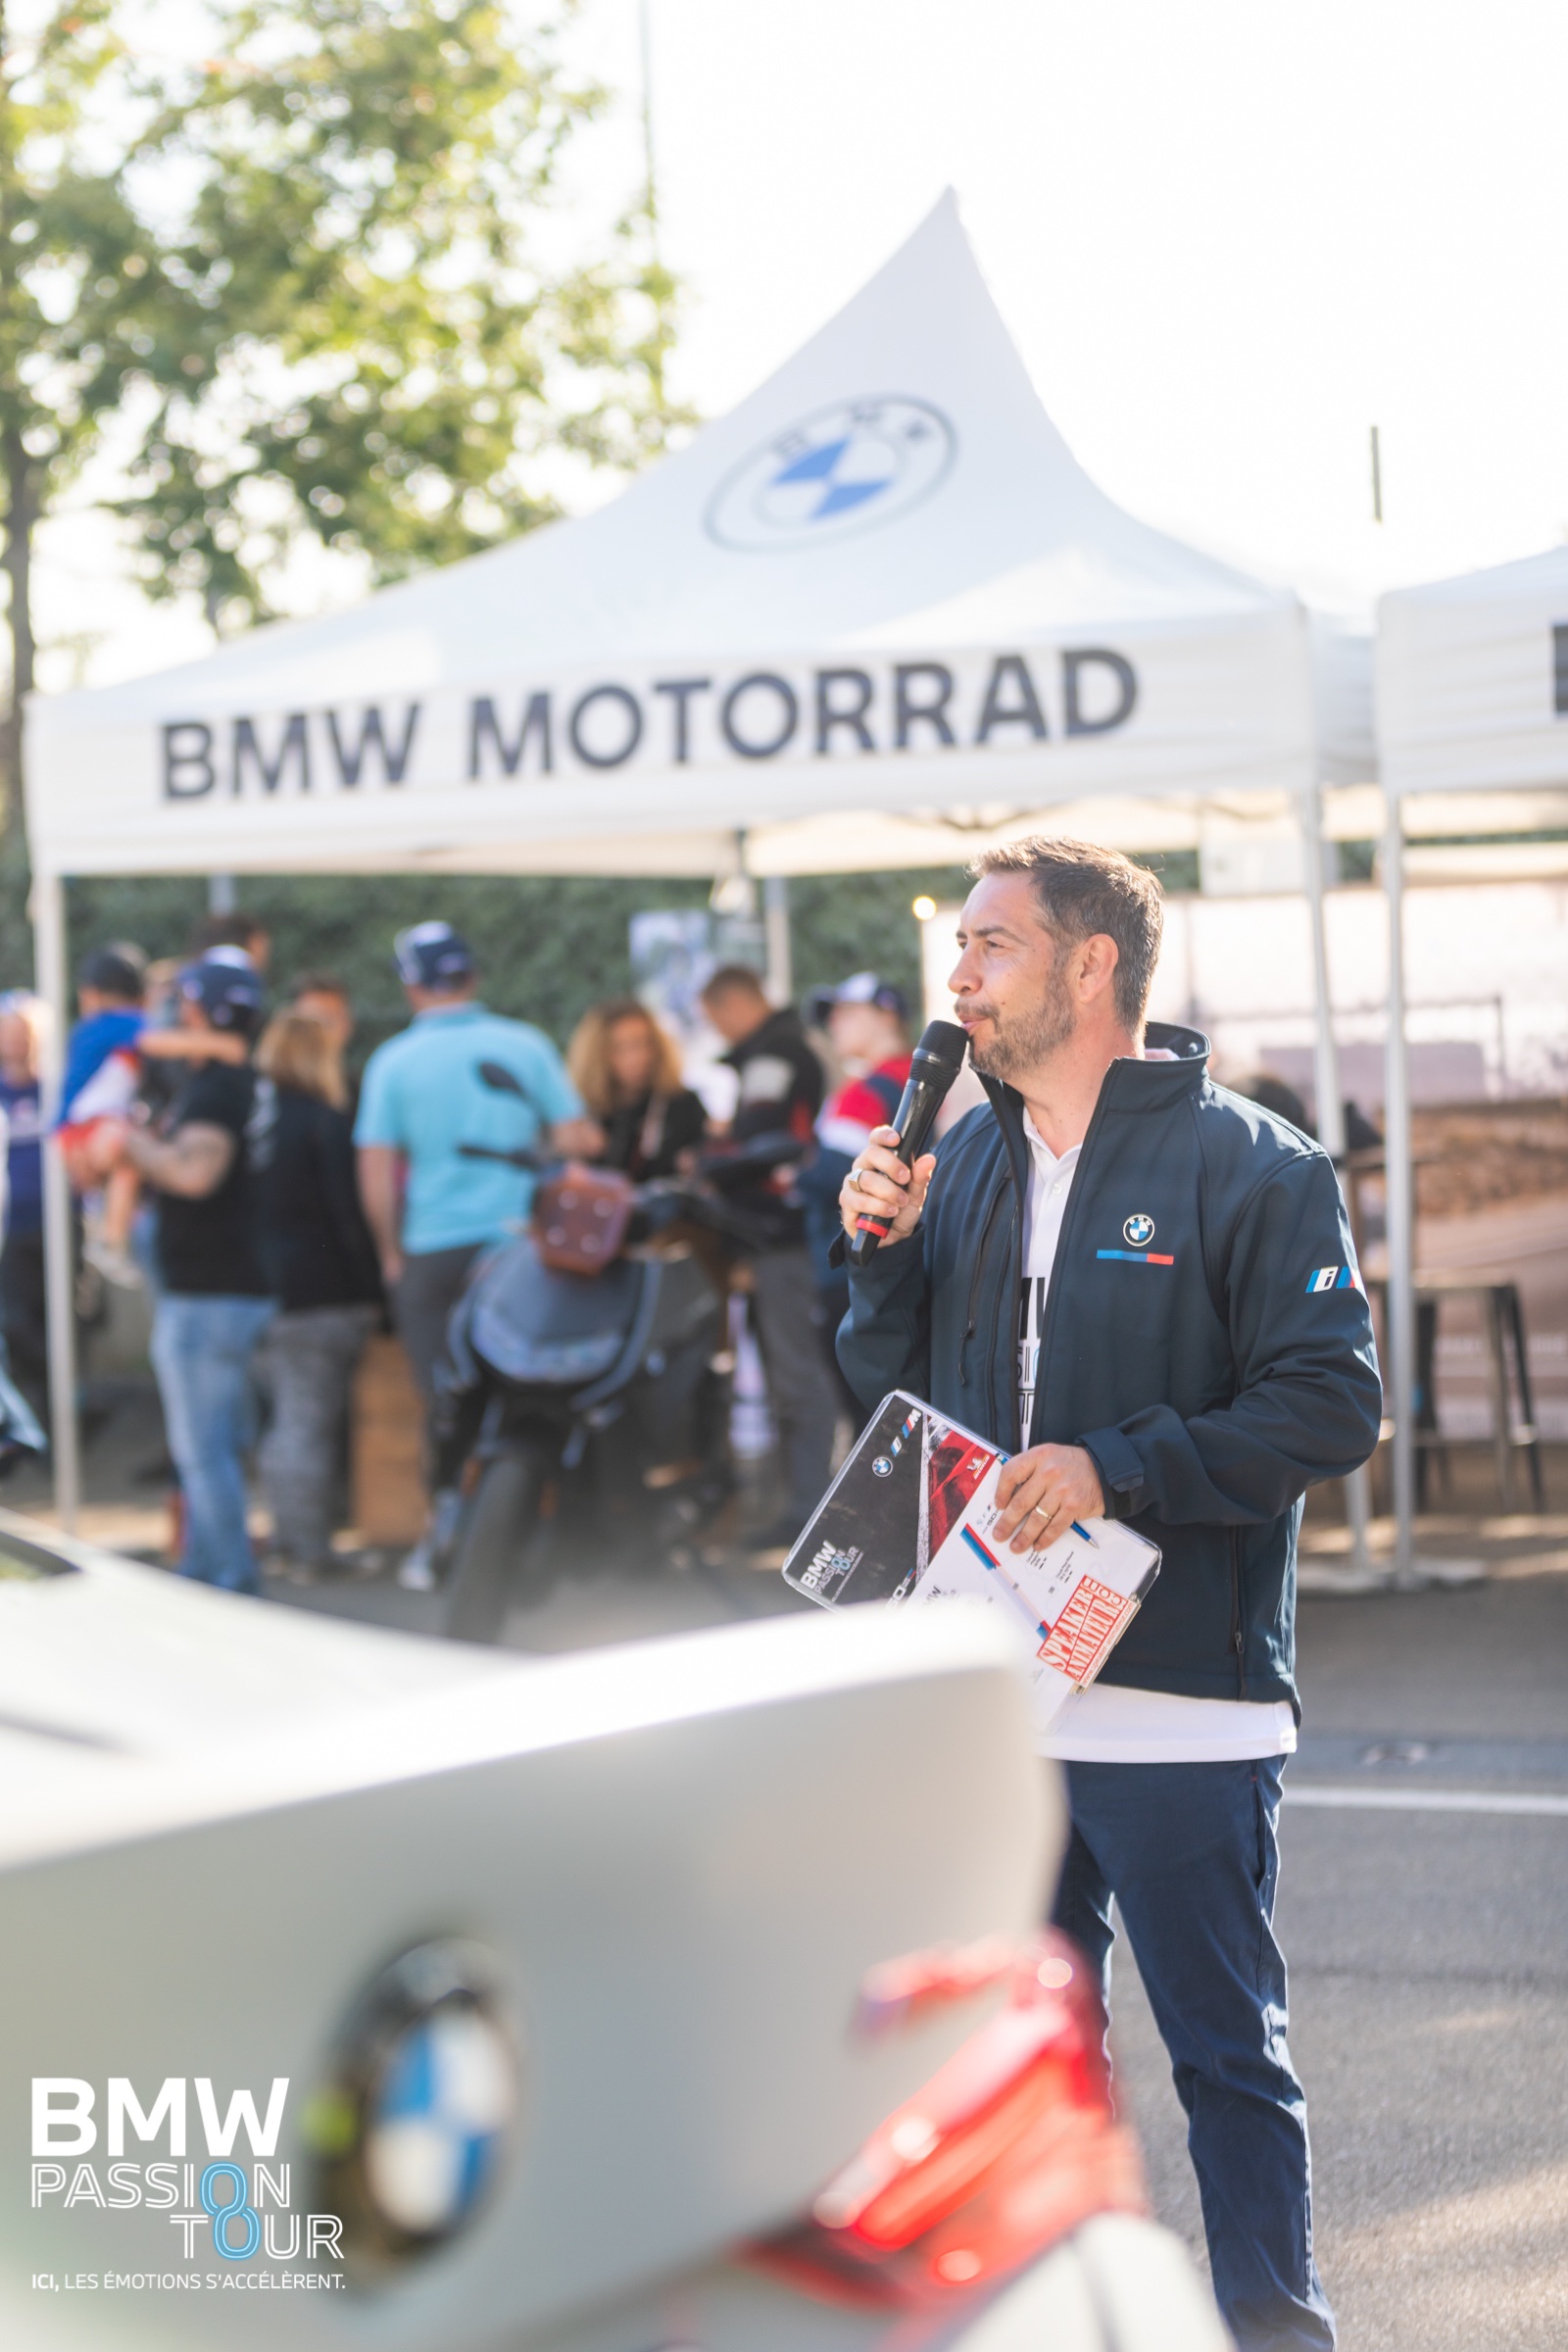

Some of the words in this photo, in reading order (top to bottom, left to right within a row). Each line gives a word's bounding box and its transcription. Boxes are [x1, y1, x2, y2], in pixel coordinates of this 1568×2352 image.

[160, 701, 421, 804] BMW
[469, 647, 1140, 781] MOTORRAD
[800, 1540, 837, 1590] BMW
[813, 1549, 846, 1594] PASSION
[835, 1545, 859, 1578] TOUR
[1039, 1587, 1094, 1670] SPEAKER
[1066, 1596, 1121, 1681] ANIMATEUR
[1081, 1602, 1135, 1686] www.speaker-animateur.com
